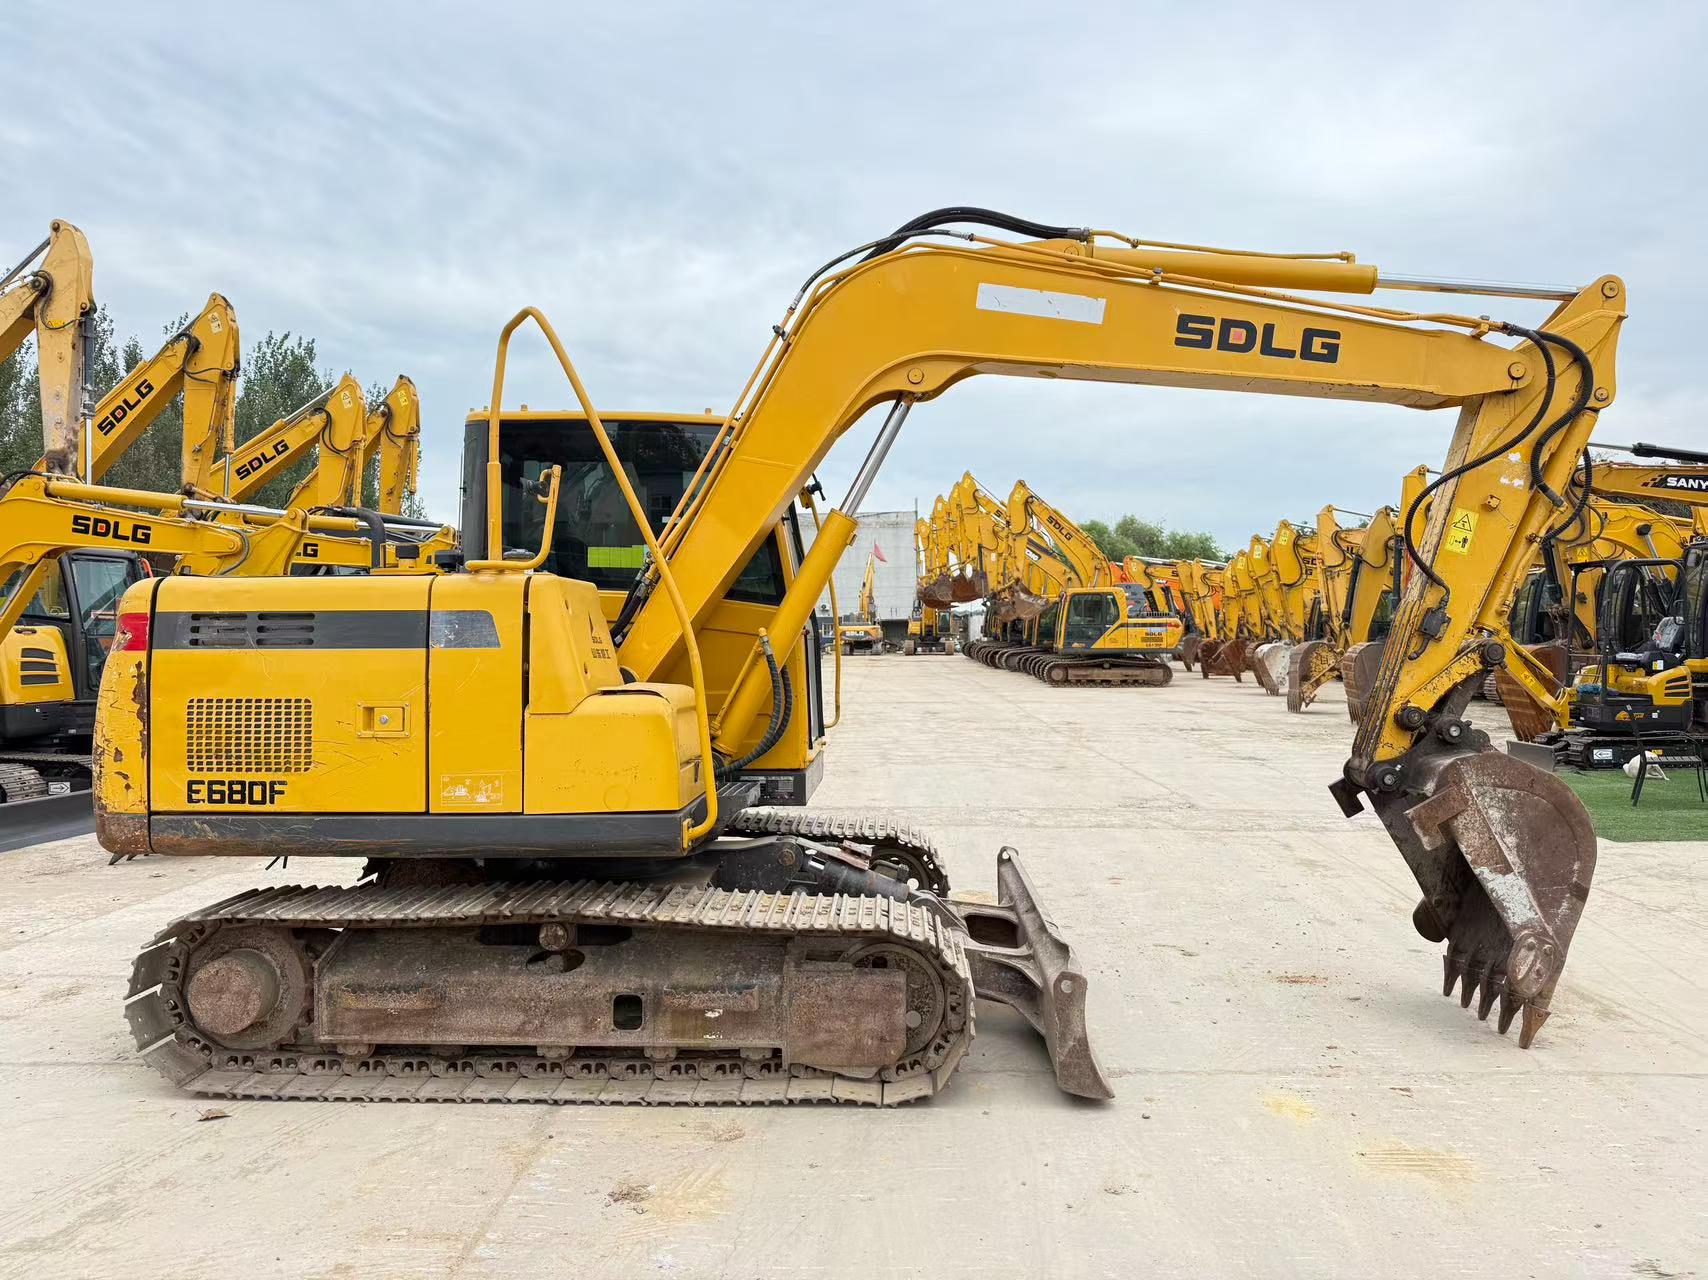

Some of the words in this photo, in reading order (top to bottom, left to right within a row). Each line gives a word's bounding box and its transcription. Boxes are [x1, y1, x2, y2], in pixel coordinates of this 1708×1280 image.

[1174, 313, 1341, 364] SDLG
[97, 379, 155, 437] SDLG
[235, 439, 290, 481] SDLG
[71, 514, 152, 544] SDLG
[1047, 516, 1073, 540] SDLG
[187, 779, 288, 805] E680F
